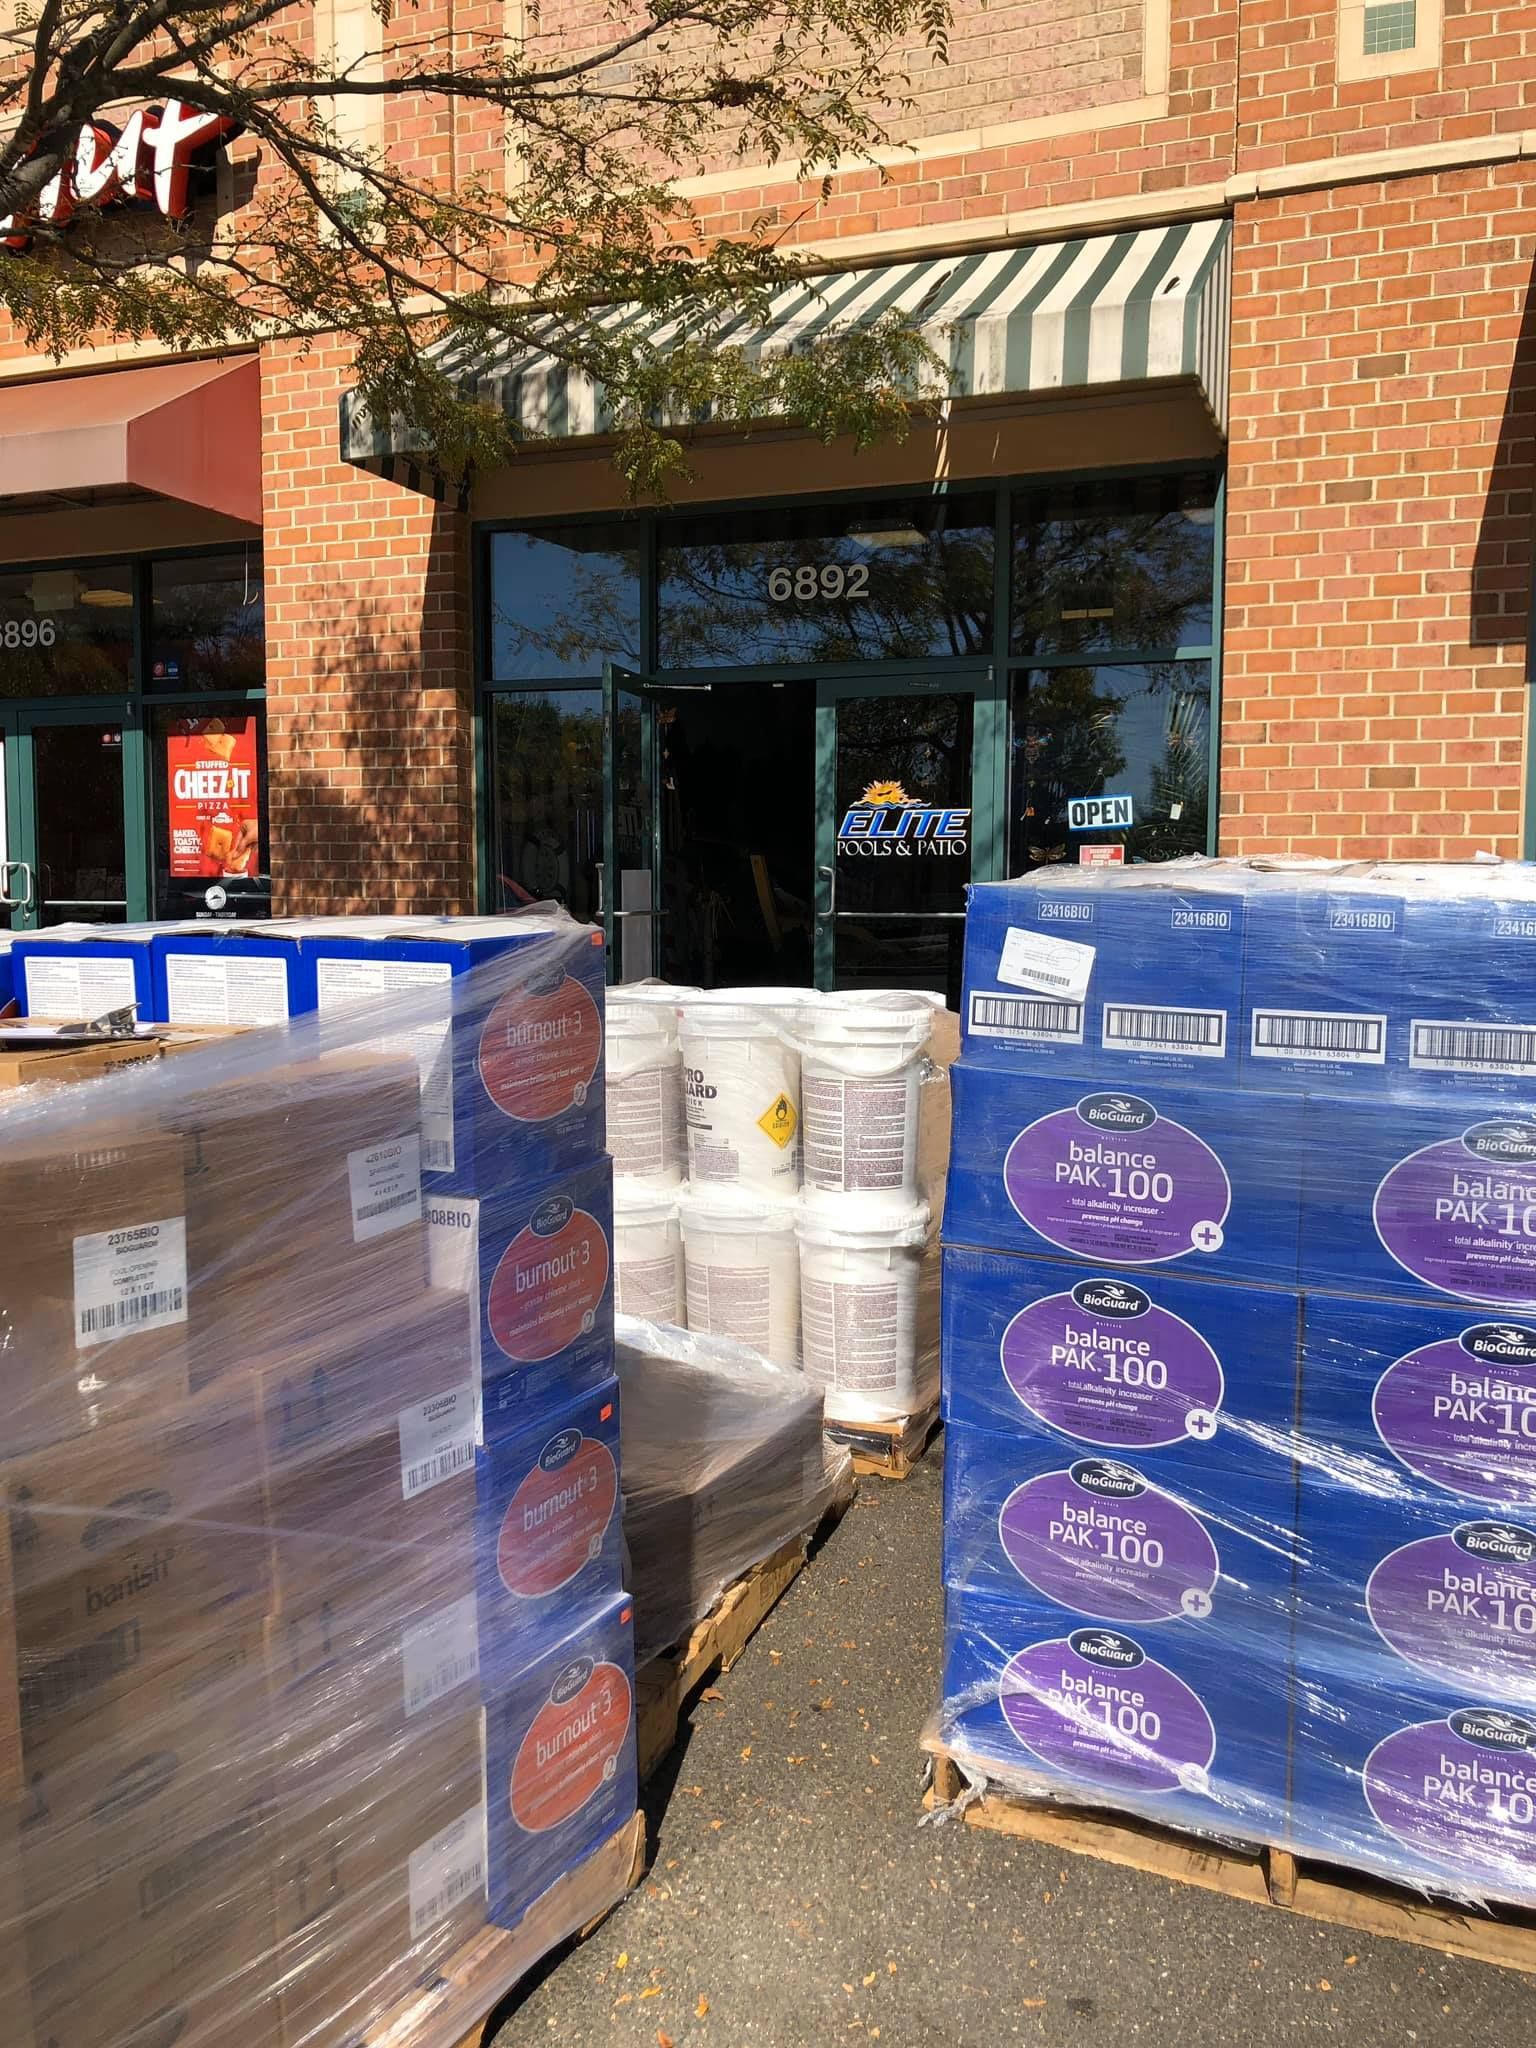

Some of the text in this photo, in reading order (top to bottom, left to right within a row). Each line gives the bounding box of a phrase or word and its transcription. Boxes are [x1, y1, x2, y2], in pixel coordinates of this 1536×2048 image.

[768, 563, 870, 601] 6892
[195, 760, 229, 769] STUFFED
[197, 802, 229, 810] PIZZA
[1071, 799, 1129, 827] OPEN
[173, 829, 199, 838] BAKED.
[837, 808, 972, 838] ELITE
[173, 837, 203, 846] TOASTY.
[836, 839, 967, 856] POOLS & PATIO
[1040, 903, 1090, 920] 23416BIO
[1173, 910, 1228, 928] 23416BIO
[1333, 911, 1391, 929] 23416BIO
[507, 1011, 582, 1047] burnout 3
[685, 1068, 704, 1083] RO
[1088, 1108, 1145, 1124] BioGuard
[1069, 1141, 1156, 1170] balance
[1055, 1162, 1173, 1203] PAK 100
[1072, 1198, 1159, 1215] total alkalinity increaser
[1435, 1198, 1489, 1225] PAK
[536, 1209, 568, 1230] BioGuard
[1081, 1213, 1143, 1227] prevents pH change
[107, 1225, 160, 1246] 23765BIO
[1454, 1235, 1471, 1245] total
[1472, 1237, 1514, 1250] alkalinity
[516, 1248, 576, 1294] burnout
[582, 1239, 590, 1265] 3
[1466, 1253, 1499, 1261] prevents
[1500, 1255, 1511, 1263] pH
[1083, 1293, 1138, 1311] BioGuard
[1065, 1324, 1150, 1357] balance
[1051, 1345, 1168, 1390] PAK 100
[1082, 1382, 1117, 1397] alkalinity
[1118, 1388, 1153, 1401] increaser
[1078, 1396, 1138, 1412] prevents pH change
[1433, 1396, 1488, 1424] PAK
[544, 1439, 577, 1467] BioGuard
[1081, 1473, 1136, 1493] BioGuard
[524, 1465, 598, 1533] burnout 3
[1062, 1501, 1147, 1536] balance
[1049, 1521, 1164, 1569] PAK 100
[1466, 1536, 1532, 1556] BioGuard
[1427, 1589, 1536, 1634] PAK 10
[1080, 1641, 1133, 1663] BioGuard
[556, 1669, 589, 1699] BioGuard
[1061, 1670, 1145, 1708] balance
[536, 1688, 613, 1767] burnout 3
[1098, 1700, 1161, 1741] 100
[1462, 1722, 1527, 1745] BioGuard
[1423, 1775, 1477, 1806] PAK
